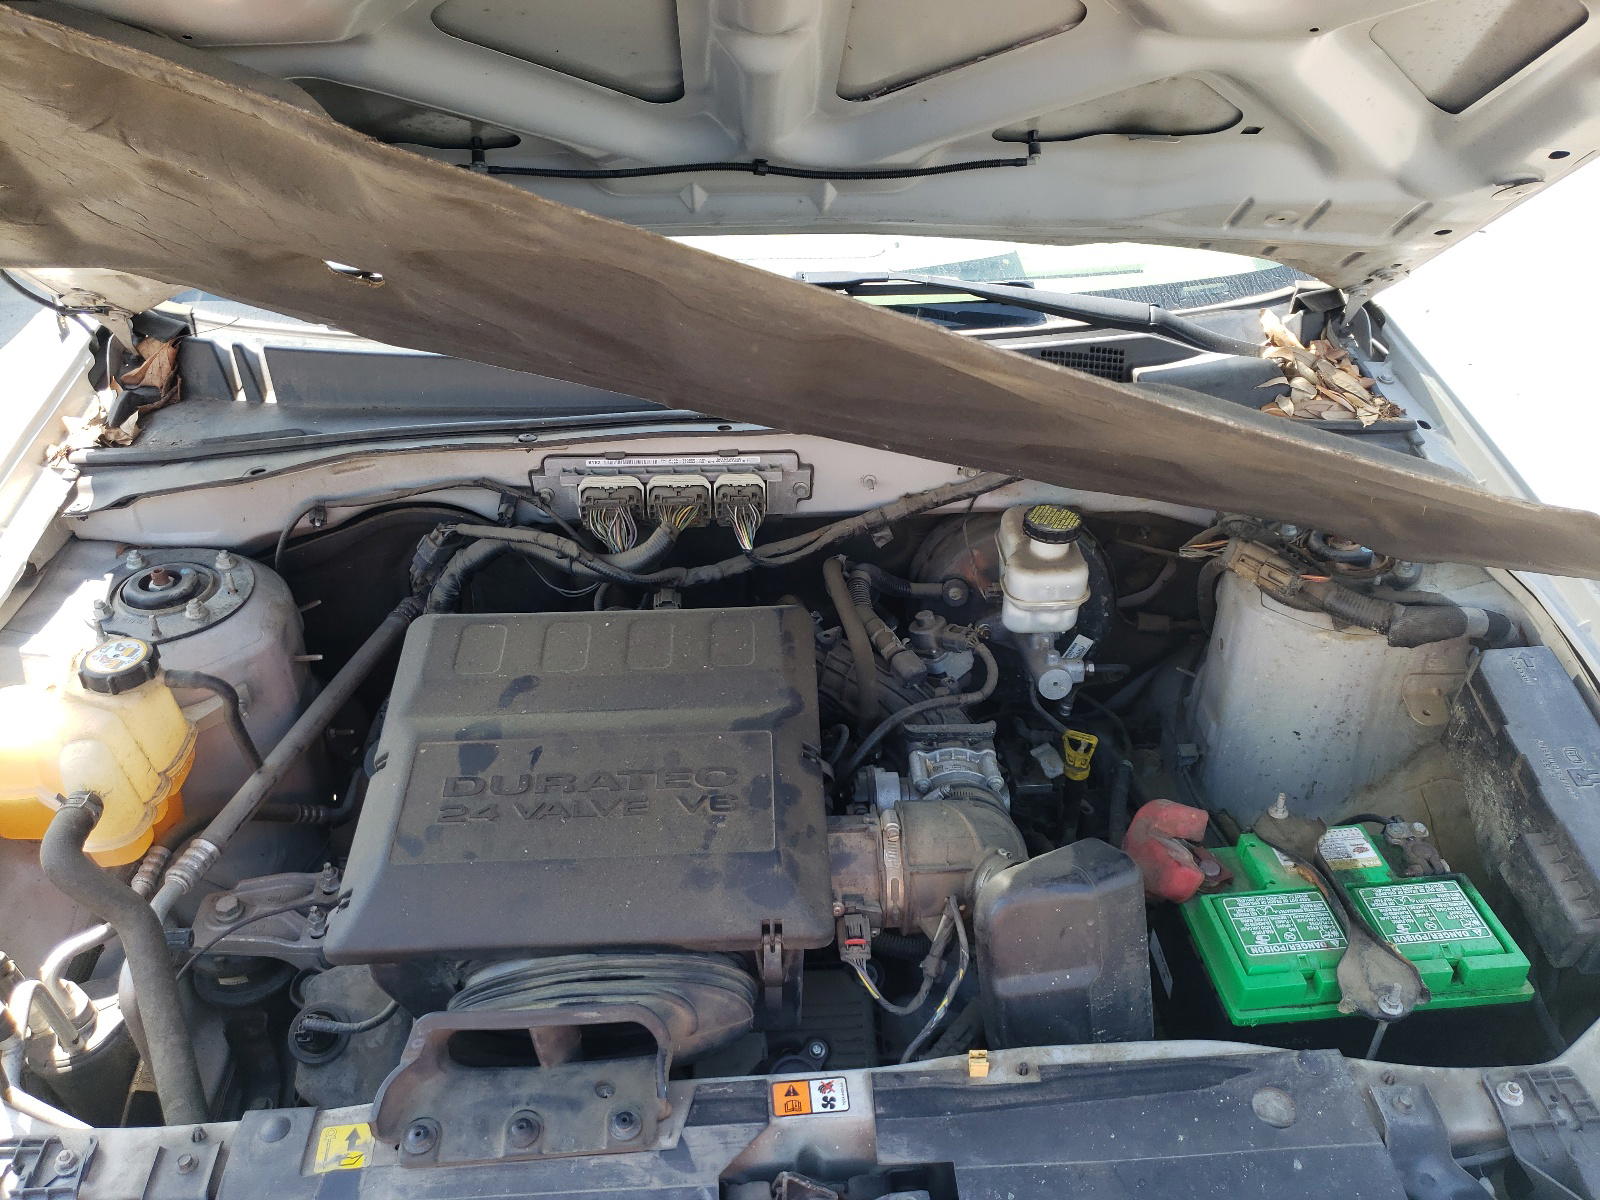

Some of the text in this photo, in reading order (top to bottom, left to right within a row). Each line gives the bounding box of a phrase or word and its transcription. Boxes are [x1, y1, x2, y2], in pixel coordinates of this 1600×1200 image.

[442, 765, 738, 798] DURATEC
[437, 793, 739, 823] 24 VALVE V6
[1393, 929, 1470, 944] DANGER/POISON
[1250, 941, 1328, 955] DANGER/POISON
